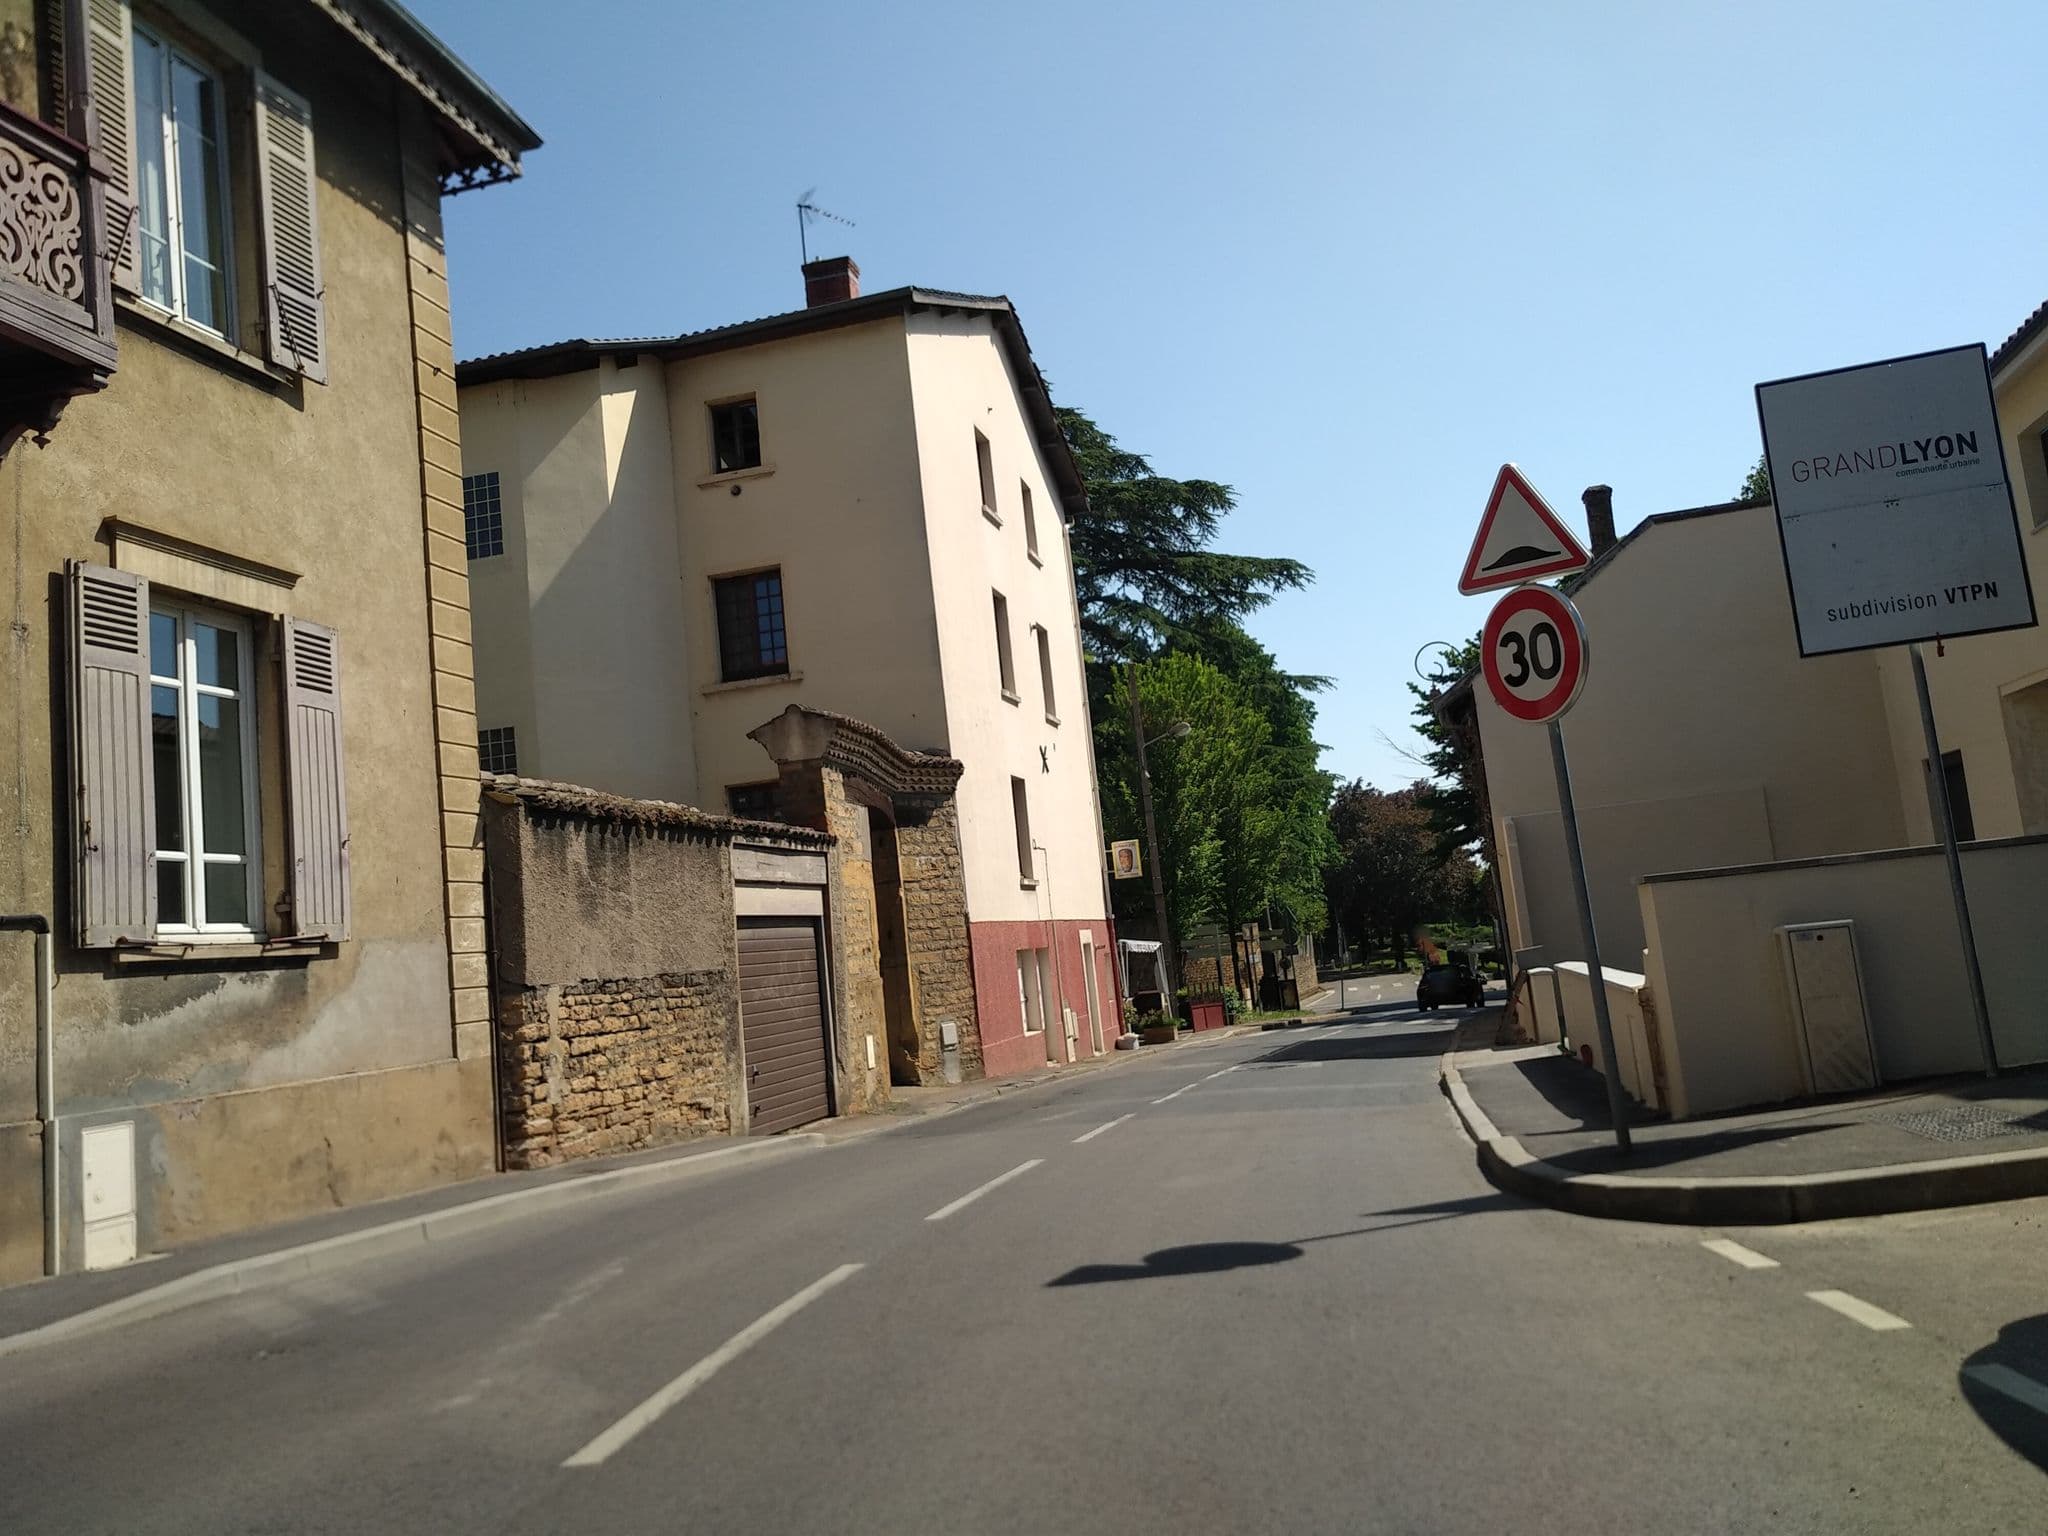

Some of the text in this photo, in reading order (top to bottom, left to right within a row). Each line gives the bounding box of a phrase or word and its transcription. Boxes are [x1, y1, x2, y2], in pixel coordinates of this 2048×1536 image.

[1948, 457, 1981, 470] urbaine
[1827, 581, 1999, 622] subdivision VTPN
[1500, 623, 1562, 687] 30
